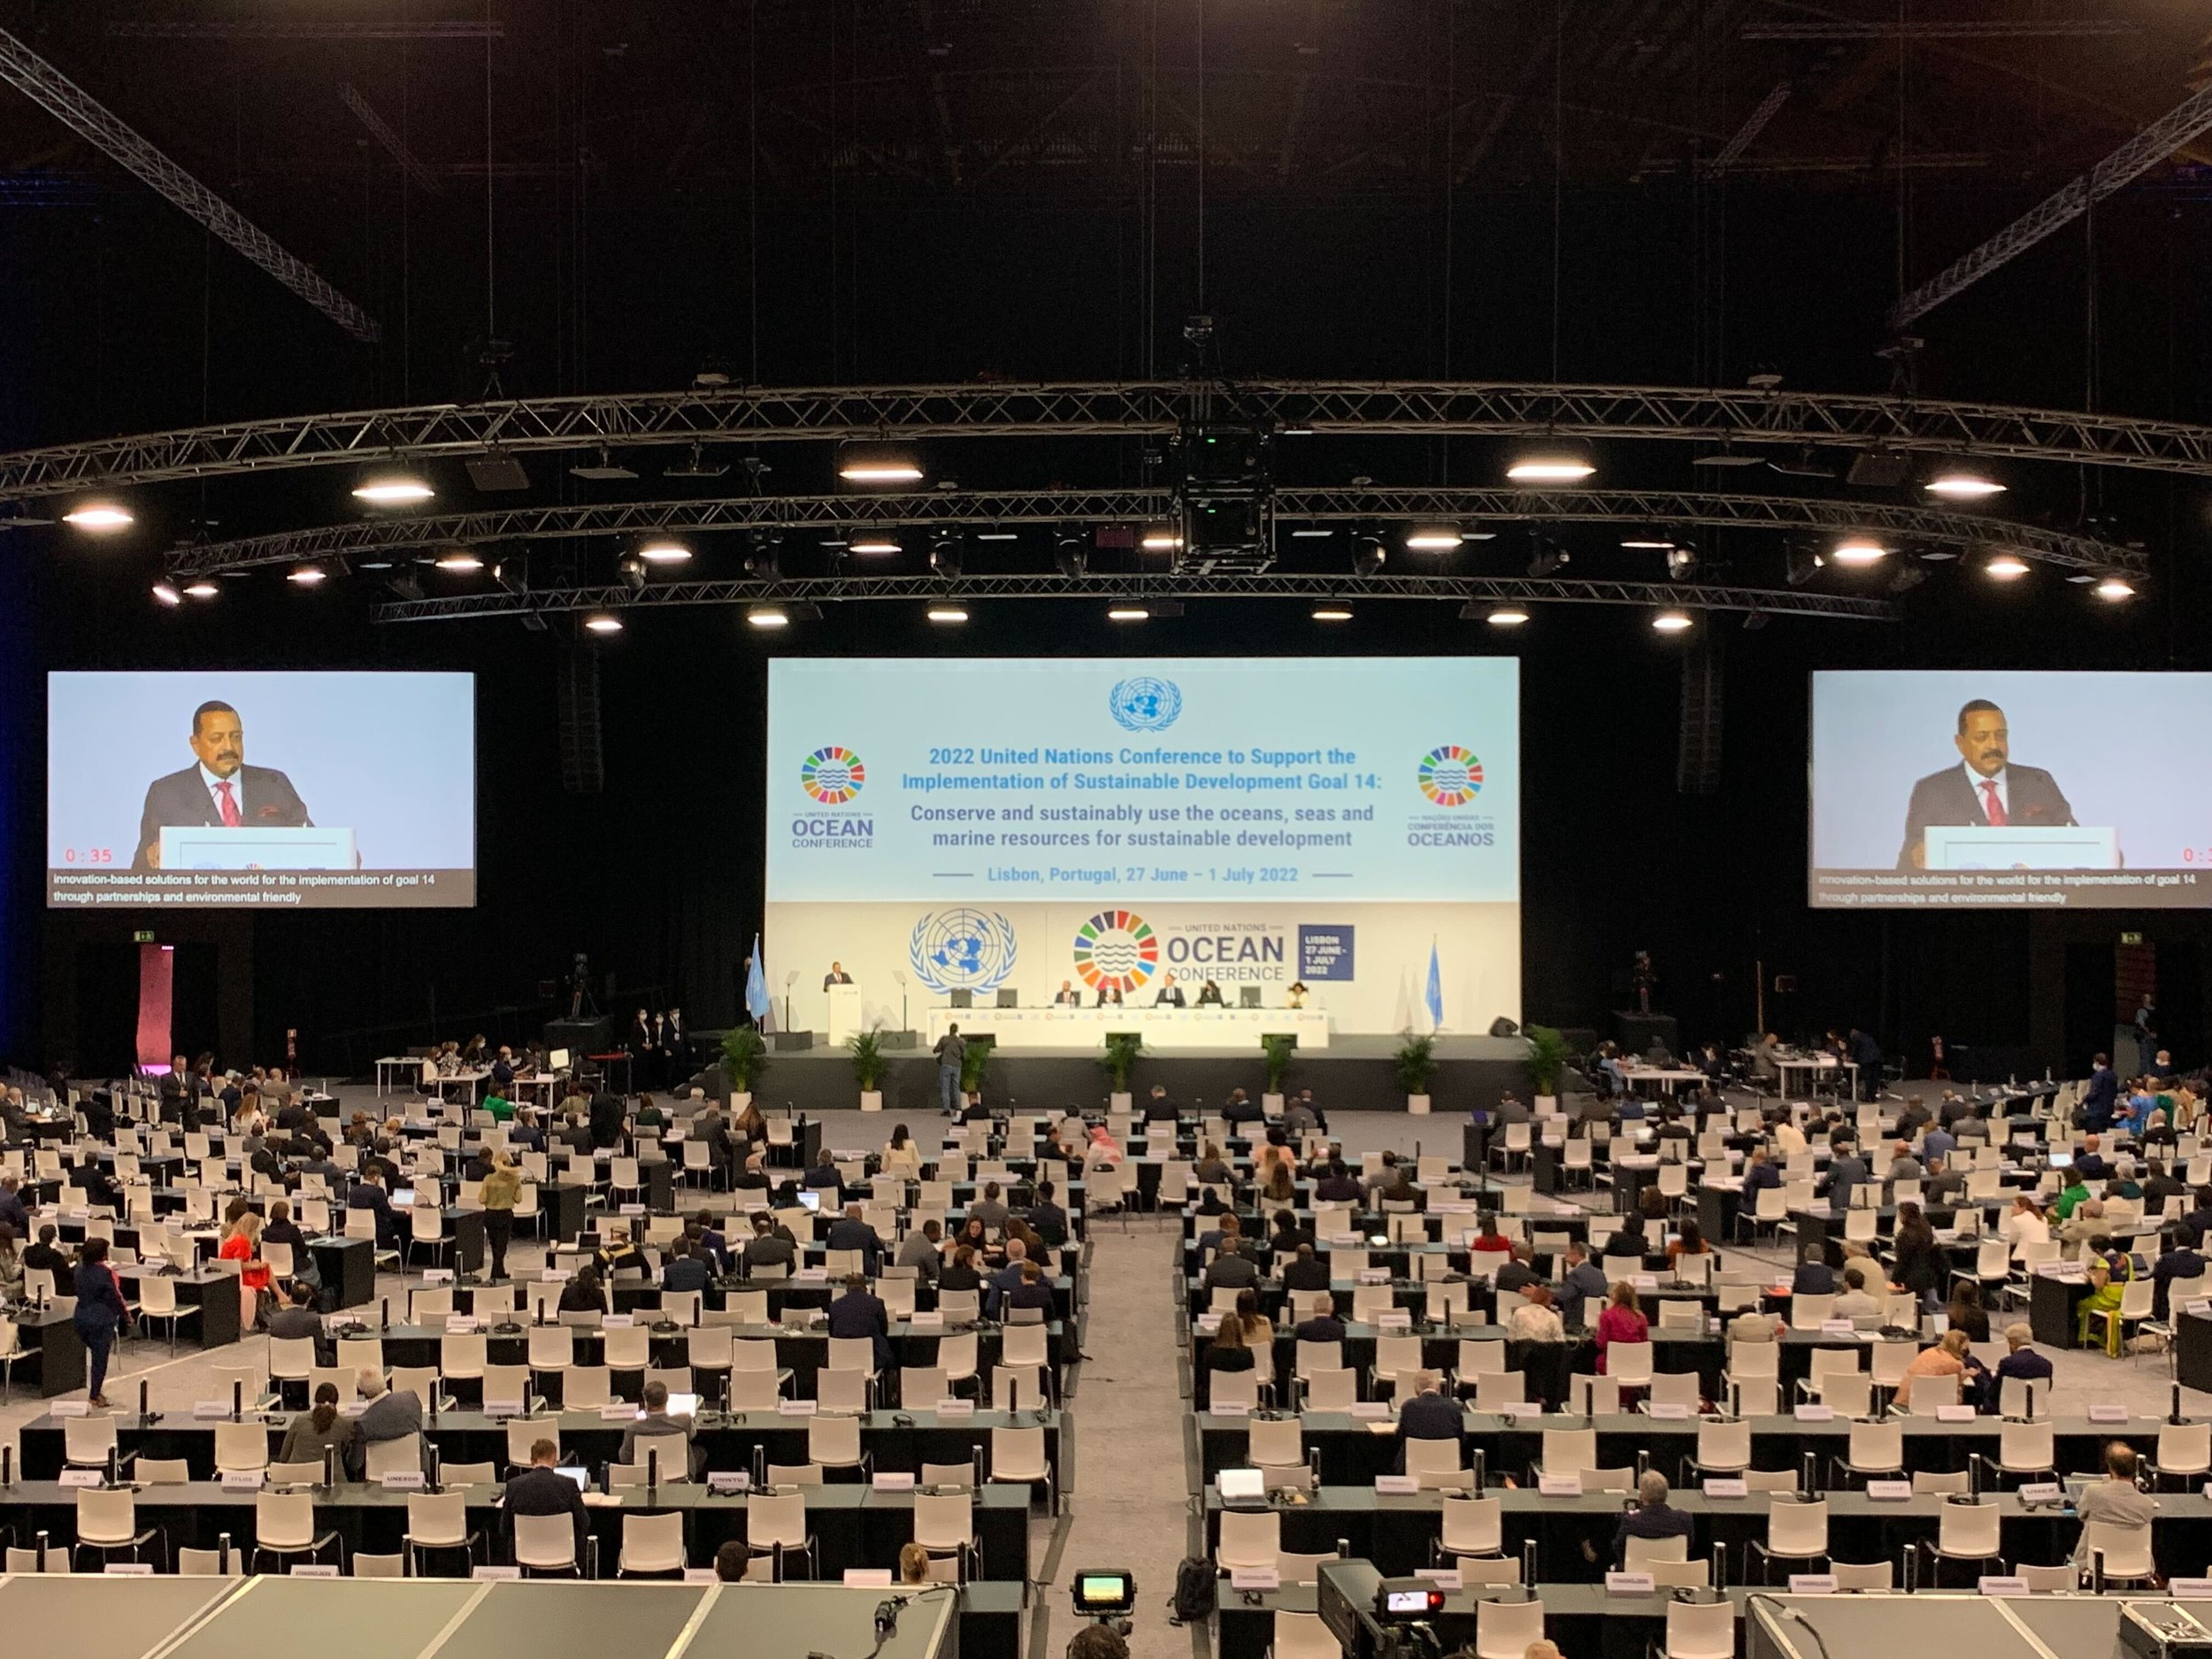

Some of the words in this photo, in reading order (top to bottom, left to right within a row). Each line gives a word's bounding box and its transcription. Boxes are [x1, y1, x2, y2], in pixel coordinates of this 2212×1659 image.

[929, 749, 974, 764] 2022
[980, 748, 1038, 764] United
[1045, 748, 1113, 764] Nations
[1119, 748, 1222, 764] Conference
[1228, 750, 1245, 764] to
[1251, 749, 1322, 768] Support
[1327, 748, 1356, 764] the
[902, 773, 1044, 793] Implementation
[1050, 772, 1069, 789] of
[1074, 773, 1179, 789] Sustainable
[1186, 773, 1302, 793] Development
[1308, 773, 1348, 789] Goal
[1355, 774, 1382, 789] 14:
[910, 805, 995, 821] Conserve
[1002, 804, 1033, 821] and
[1040, 804, 1142, 825] sustainably
[1149, 808, 1180, 821] use
[1187, 804, 1214, 821] the
[1220, 808, 1288, 824] oceans,
[1294, 808, 1335, 821] seas
[1341, 804, 1373, 821] and
[792, 819, 873, 836] OCEAN
[792, 839, 873, 849] CONFERENCE
[933, 830, 995, 846] marine
[1002, 833, 1090, 846] resources
[1096, 830, 1122, 846] for
[1127, 830, 1231, 847] sustainable
[1236, 830, 1352, 850] development
[1408, 833, 1494, 846] OCEANOS
[54, 874, 143, 885] innovation-based
[145, 874, 192, 885] solutions
[194, 874, 208, 885] for
[211, 874, 227, 885] the
[230, 874, 258, 885] world
[262, 874, 276, 885] for
[280, 874, 296, 885] the
[299, 874, 380, 887] implementation
[382, 874, 394, 885] of
[396, 874, 419, 887] goal
[422, 874, 435, 885] 14
[987, 867, 1045, 884] Lisbon,
[1049, 867, 1121, 885] Portugal,
[1126, 867, 1145, 881] 27
[1150, 867, 1188, 882] June
[1209, 867, 1217, 881] 1
[1223, 867, 1255, 885] July
[1259, 867, 1298, 882] 2022
[1909, 874, 1957, 885] solutions
[1959, 874, 1974, 885] for
[1977, 874, 1993, 885] the
[1996, 874, 2025, 885] world
[2027, 874, 2041, 885] for
[2044, 874, 2062, 885] the
[2063, 874, 2142, 887] implementation
[2144, 874, 2154, 885] of
[2156, 874, 2179, 887] goal
[2183, 874, 2196, 885] 14
[54, 892, 93, 903] through
[96, 892, 161, 903] partnerships
[163, 892, 183, 902] and
[185, 892, 260, 902] environmental
[262, 892, 301, 904] friendly
[1861, 893, 1925, 904] partnerships
[1928, 893, 1948, 903] and
[1951, 893, 2025, 903] environmental
[2028, 892, 2067, 904] friendly
[1185, 924, 1221, 933] UNITED
[1304, 935, 1340, 945] LISBON
[1167, 936, 1283, 963] OCEAN
[1304, 946, 1317, 955] 27
[1305, 956, 1310, 965] 1
[1312, 956, 1337, 965] JULY
